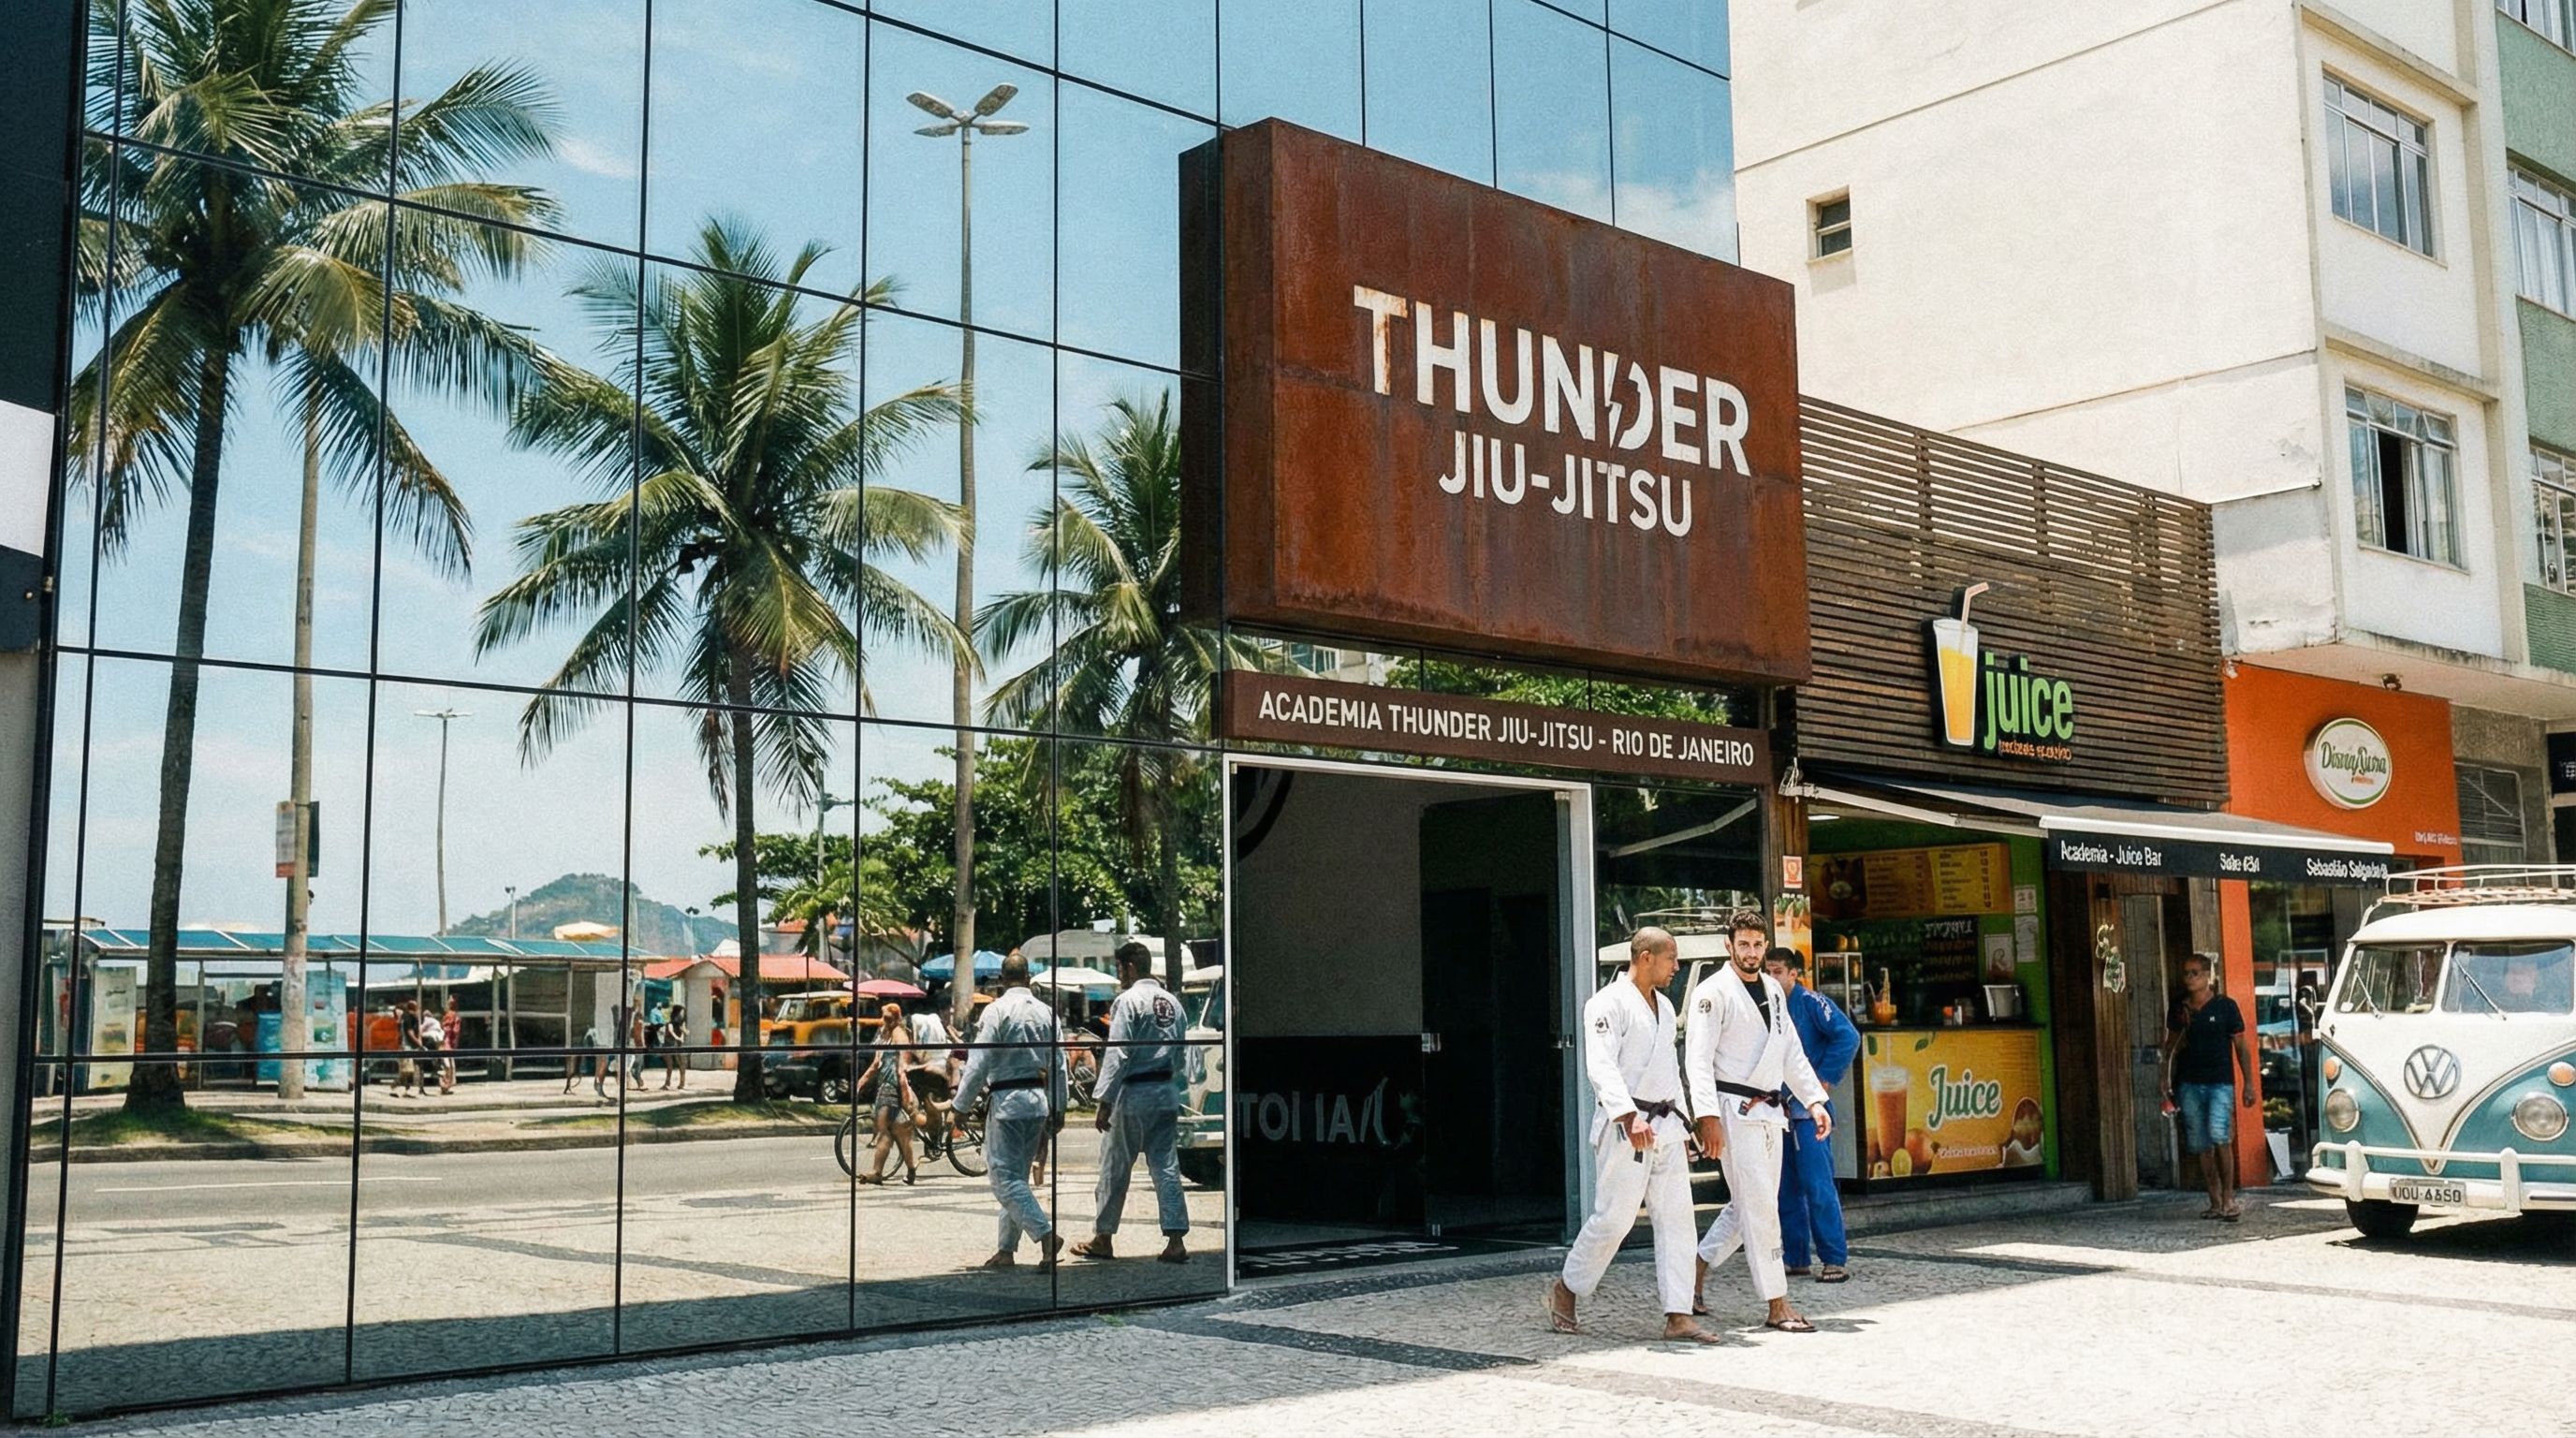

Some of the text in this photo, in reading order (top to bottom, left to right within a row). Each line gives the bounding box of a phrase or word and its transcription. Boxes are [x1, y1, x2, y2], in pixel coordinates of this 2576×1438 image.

[1354, 285, 1752, 477] THUNDER
[1438, 430, 1692, 537] JIU-JITSU
[1259, 690, 1383, 731] ACADEMIA
[1388, 704, 1492, 741] THUNDER
[1497, 716, 1593, 751] JIU-JITSU
[1612, 728, 1644, 756] RIO
[1648, 732, 1674, 759] DE
[1677, 736, 1755, 768] JANEIRO
[1983, 652, 2074, 750] juice
[2144, 846, 2162, 867] Bar
[1927, 1065, 2000, 1130] Juice
